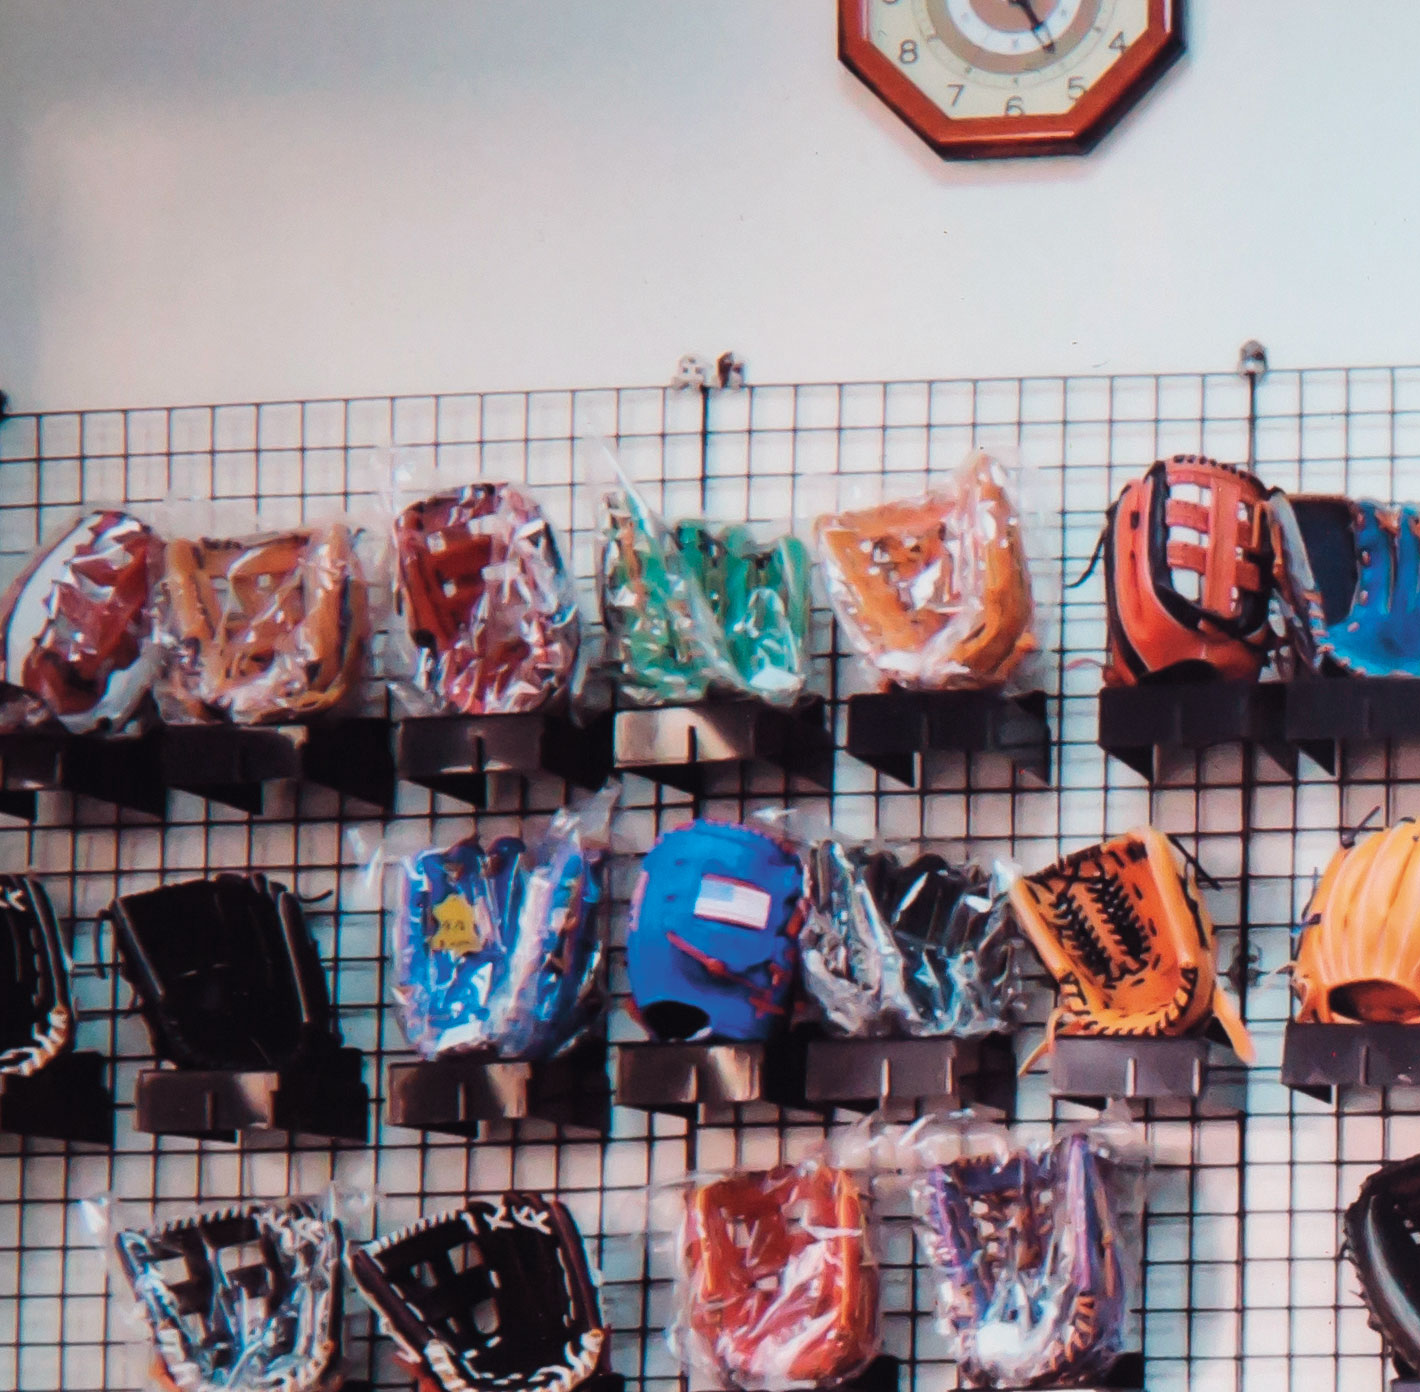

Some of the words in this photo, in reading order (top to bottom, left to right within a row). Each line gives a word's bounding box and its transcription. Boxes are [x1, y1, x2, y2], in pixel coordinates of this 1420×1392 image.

[898, 39, 918, 64] 8
[1108, 31, 1127, 54] 4
[947, 84, 964, 106] 7
[1067, 77, 1087, 100] 5
[1004, 96, 1025, 117] 6
